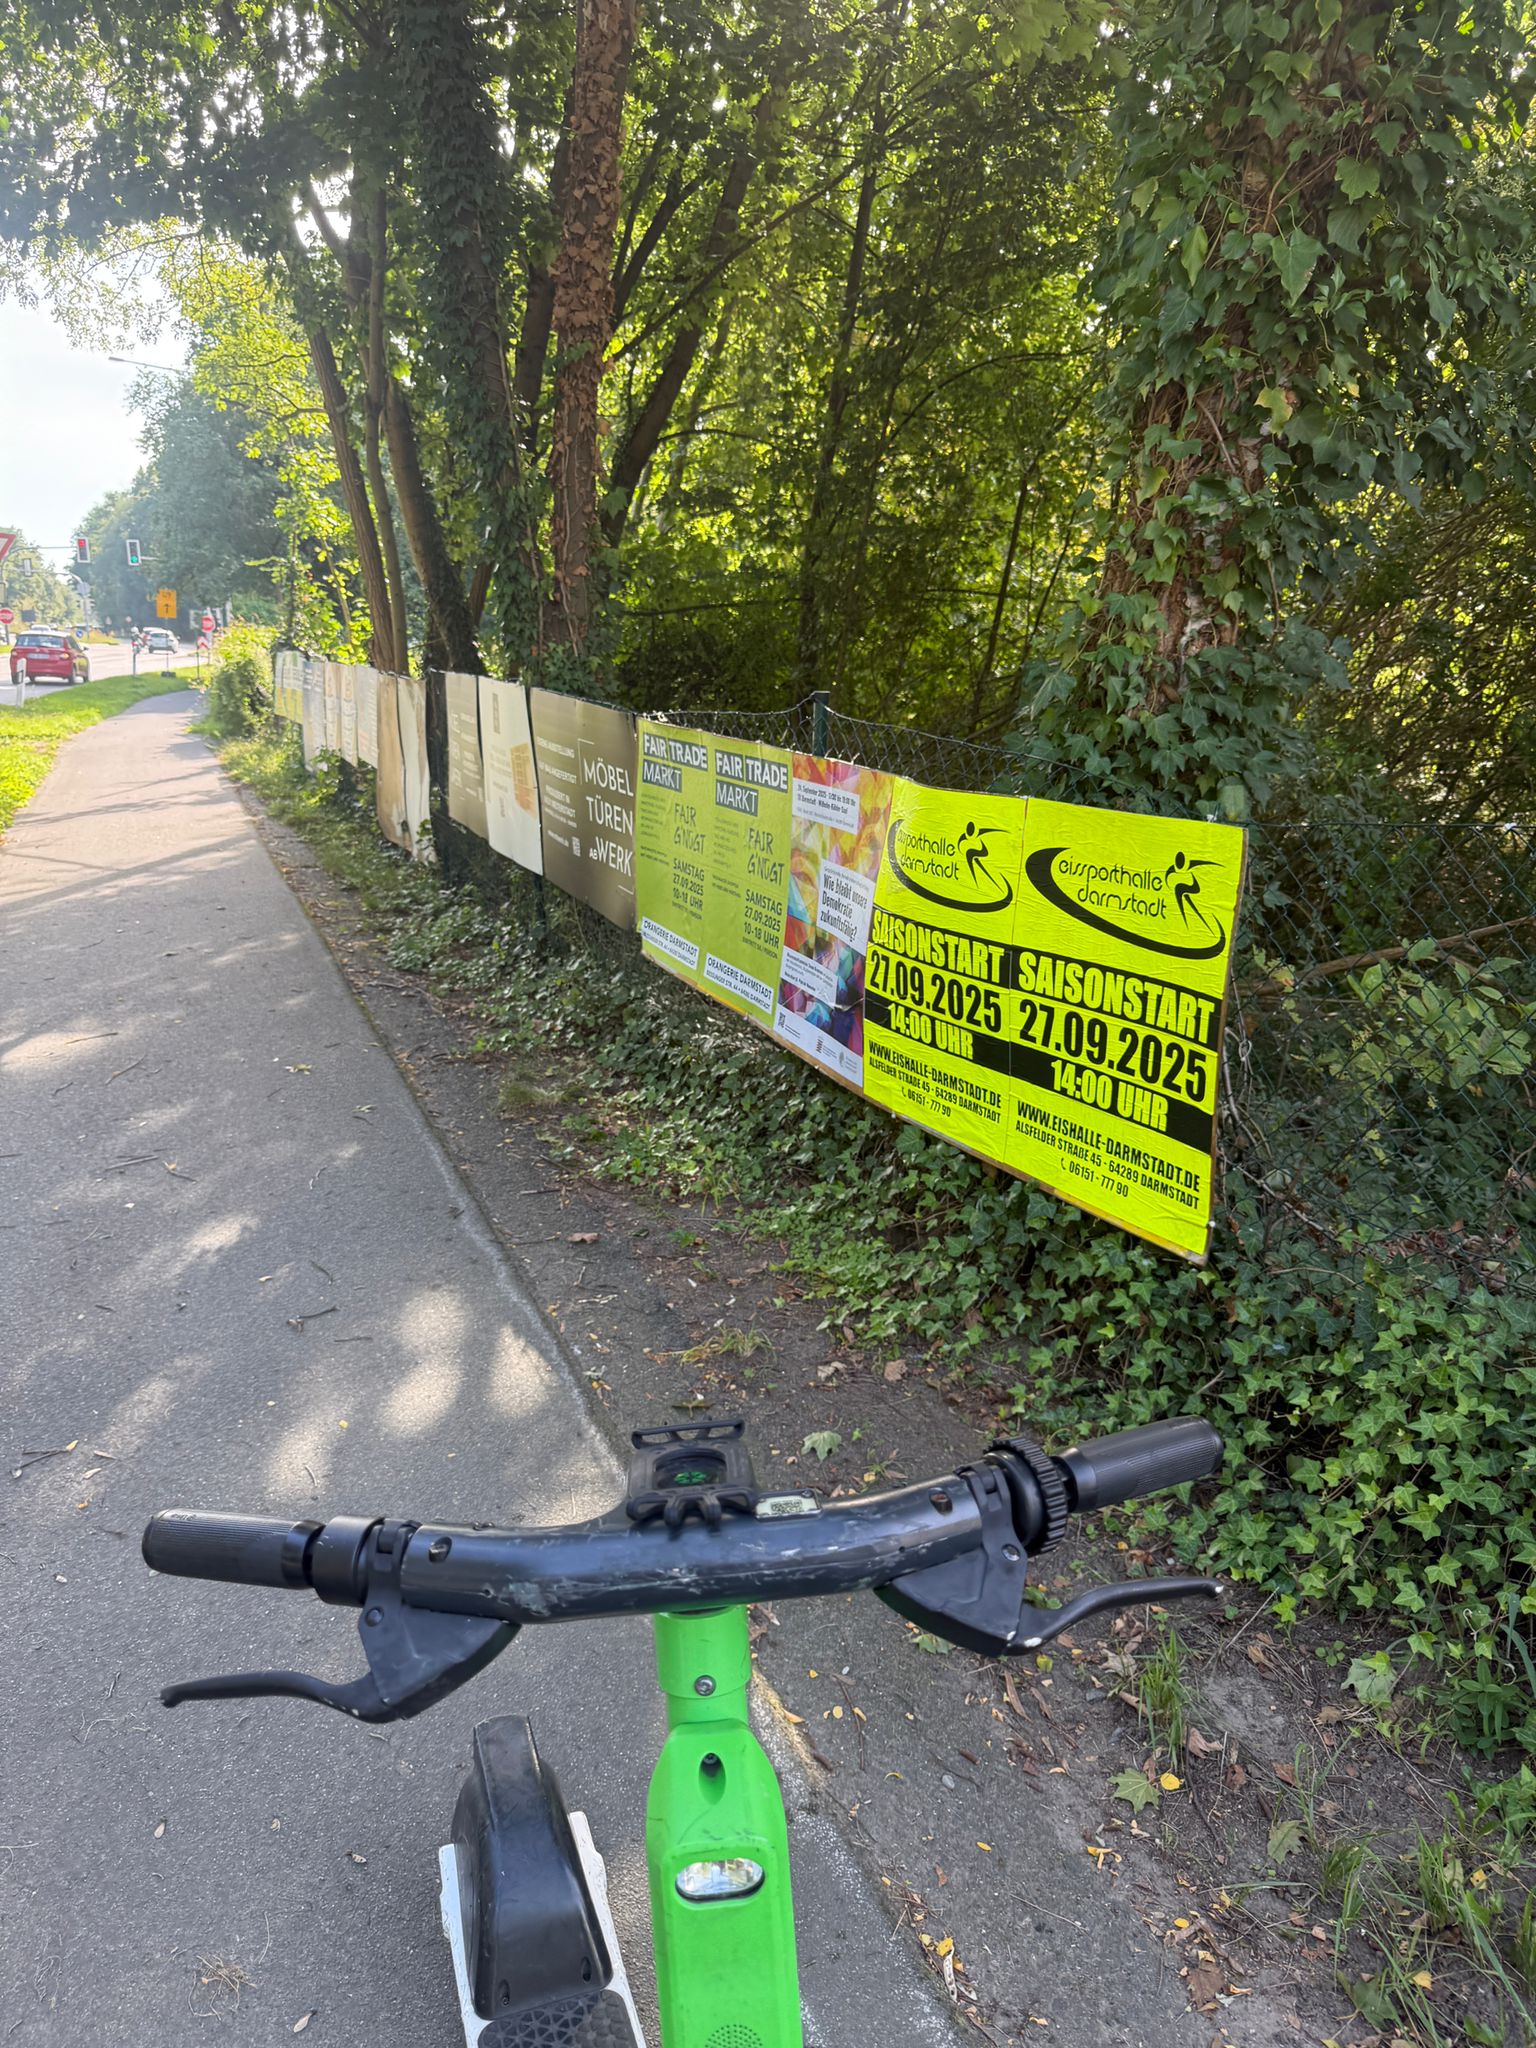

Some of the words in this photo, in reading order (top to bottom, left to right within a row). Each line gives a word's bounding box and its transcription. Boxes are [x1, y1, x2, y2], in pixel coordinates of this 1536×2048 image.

[643, 734, 667, 758] FAIR
[669, 741, 707, 769] TRADE
[583, 757, 634, 797] MÖBEL
[643, 762, 681, 789] MARKT
[716, 752, 742, 778] FAIR
[746, 759, 788, 790] TRADE
[585, 795, 633, 836] TÜREN
[674, 802, 696, 826] FAIR
[716, 782, 757, 813] MARKT
[749, 827, 774, 855] FAIR
[673, 858, 704, 881] SAMSTAG
[900, 852, 960, 880] darmstadt
[1058, 856, 1163, 892] eissporthalle
[745, 888, 782, 916] SAMSTAG
[822, 890, 853, 919] Demokratie
[823, 873, 835, 891] Wie
[835, 878, 852, 900] bleibt
[1077, 885, 1167, 920] darmstadt
[744, 905, 780, 932] 27.09.2025
[820, 910, 858, 942] zukunftsfähig?
[643, 920, 669, 941] ORANGERIE
[668, 933, 698, 957] DARMSTADT
[763, 930, 780, 949] UHR
[872, 909, 1005, 983] SAISONSTART
[707, 957, 740, 981] ORANGERIE
[739, 973, 772, 1001] DARMSTADT
[870, 949, 1002, 1033] 27.09.2025
[1018, 951, 1216, 1045] SAISONSTART
[888, 1001, 932, 1044] 14:00
[935, 1019, 974, 1060] UHR
[1019, 999, 1208, 1103] 27.09.2025
[868, 1039, 1002, 1109] WWW.EISHALLE-DARMSTADT.DE
[907, 1087, 926, 1106] 06151
[930, 1099, 941, 1113] 777
[921, 1081, 930, 1093] 45
[935, 1086, 958, 1104] 64289
[958, 1096, 1001, 1124] DARMSTADT
[1050, 1059, 1113, 1110] 14:00
[1116, 1081, 1169, 1133] UHR
[1017, 1100, 1201, 1193] WWW.EISHALLE-DARMSTADT.DE
[1015, 1120, 1056, 1147] ALSFELDER
[1090, 1151, 1102, 1167] 45
[1108, 1159, 1139, 1183] 64289
[1140, 1172, 1200, 1210] DARMSTADT
[1068, 1160, 1095, 1182] 06151
[1100, 1174, 1115, 1191] 777
[1116, 1183, 1129, 1198] 90
